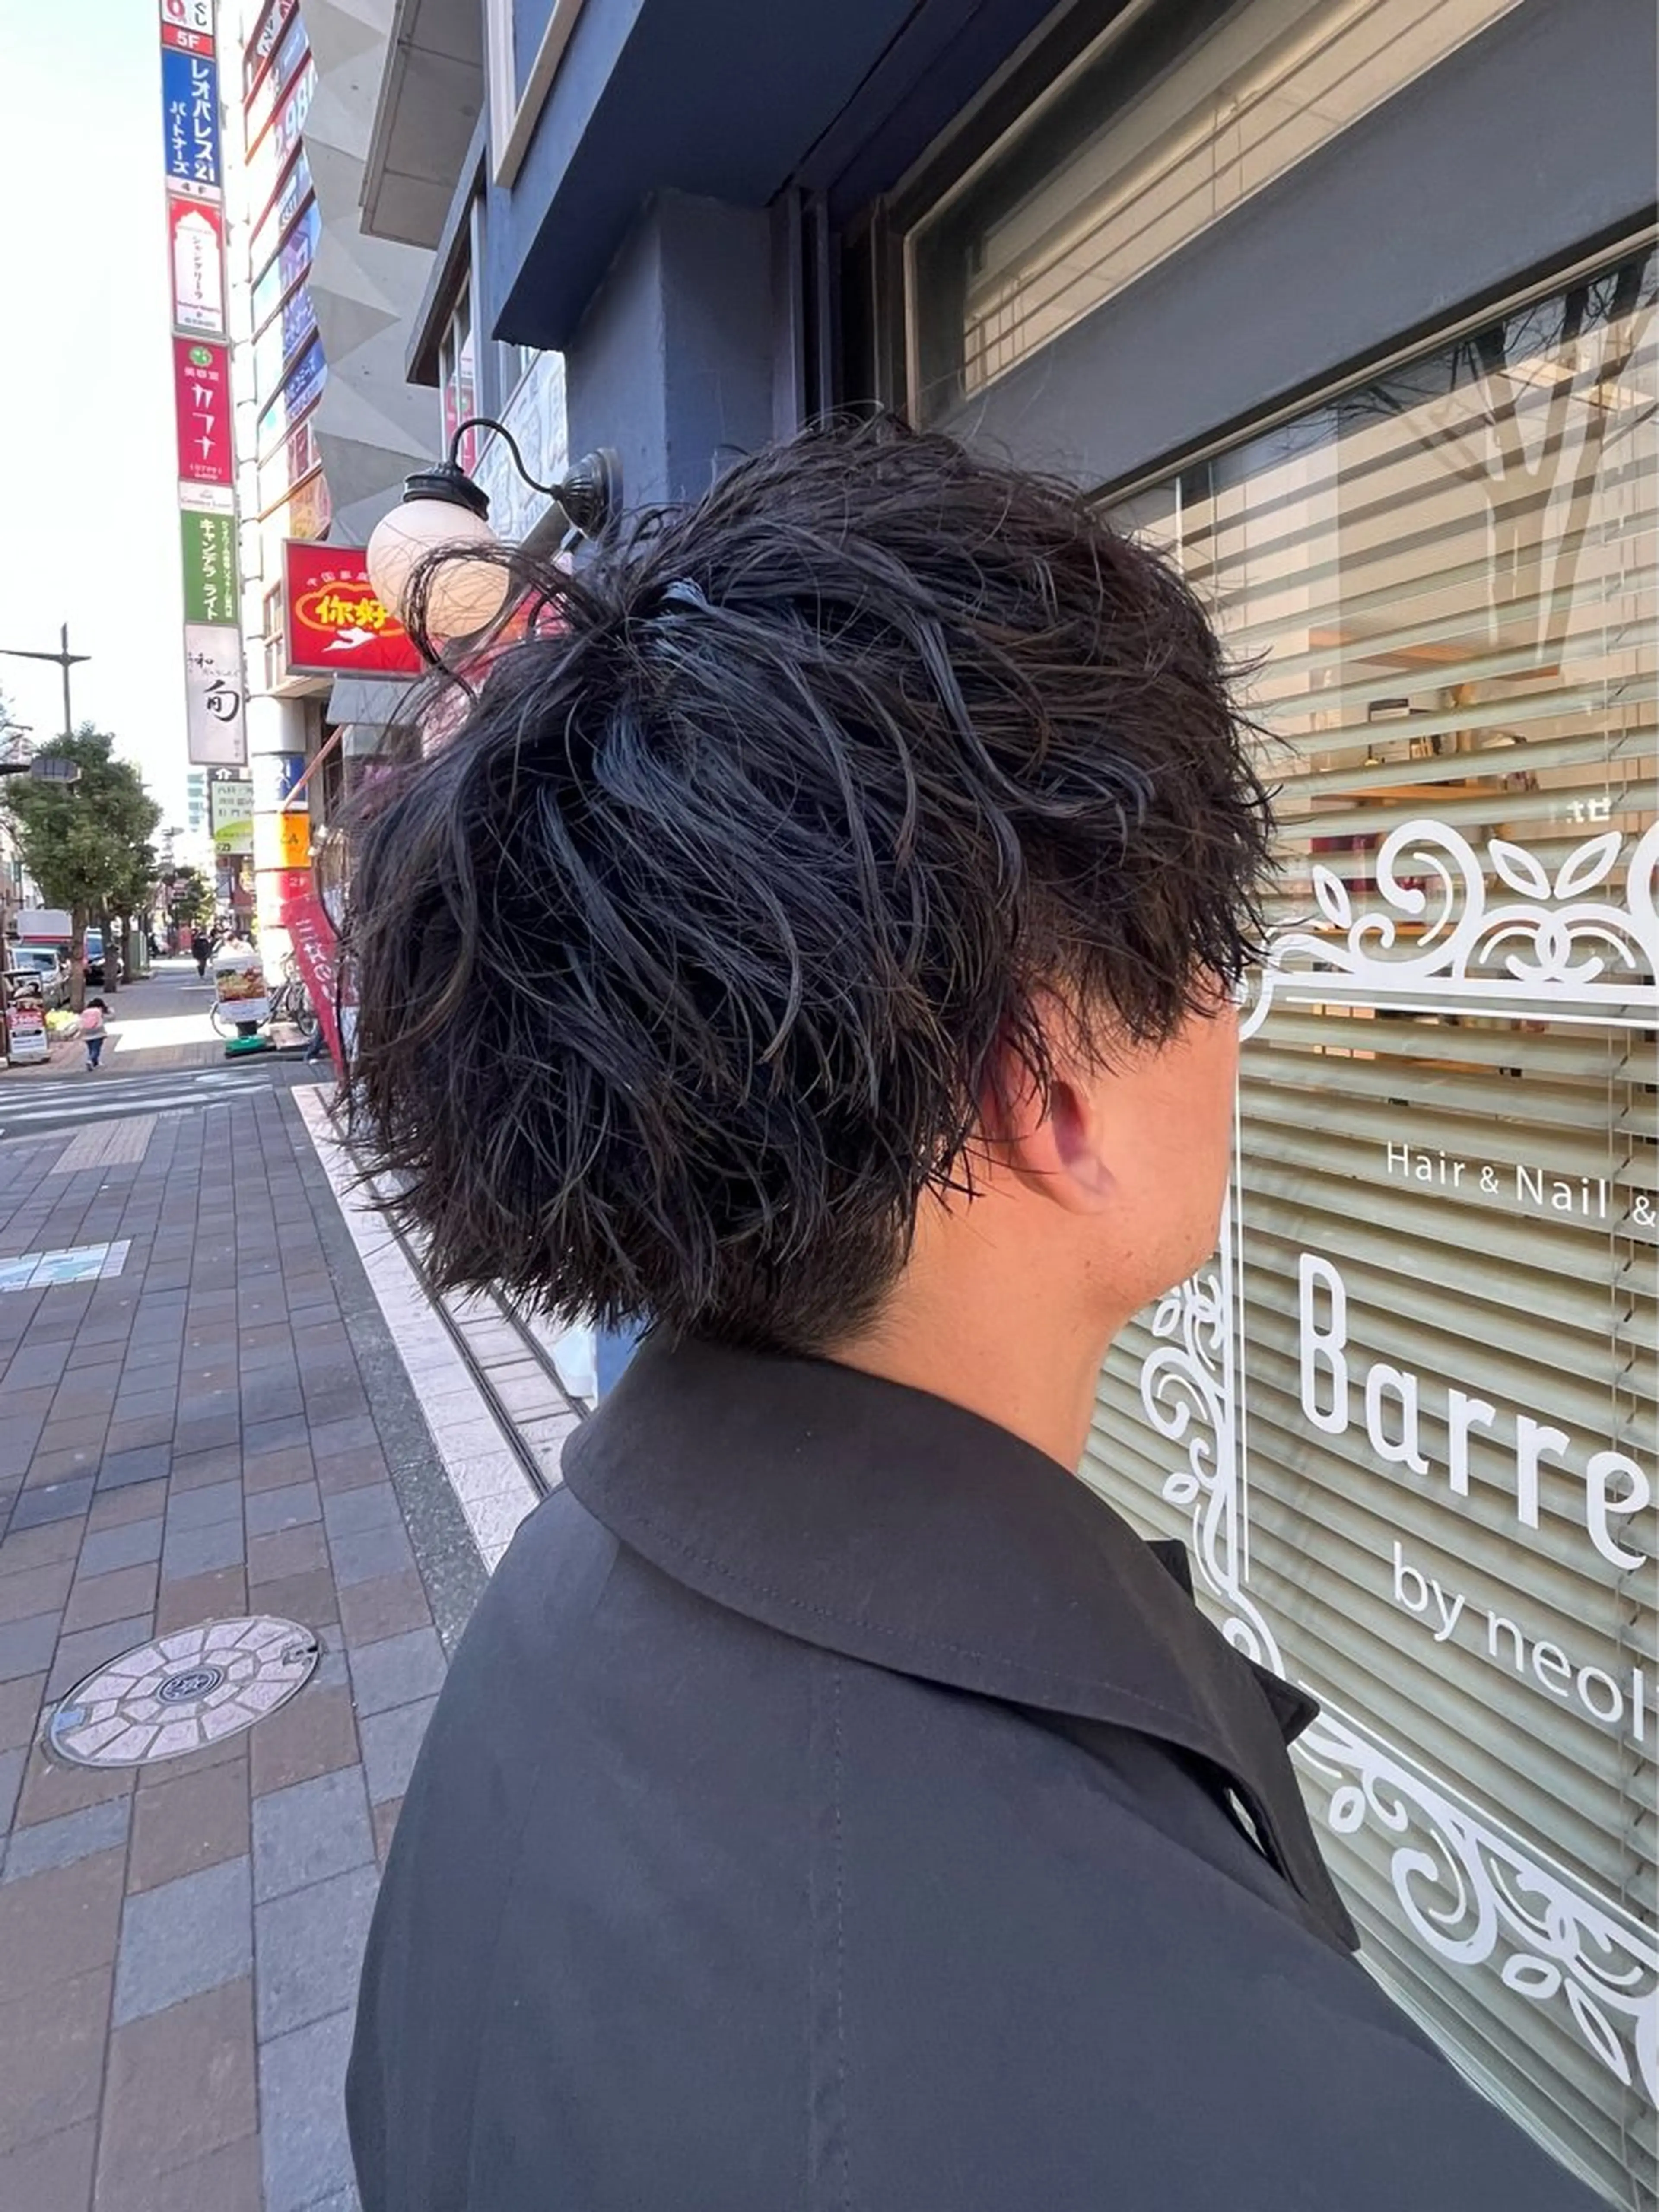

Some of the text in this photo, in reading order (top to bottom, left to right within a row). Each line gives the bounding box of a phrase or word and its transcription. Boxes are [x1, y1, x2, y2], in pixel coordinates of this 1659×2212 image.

[176, 30, 200, 49] 5F
[169, 99, 190, 175] パートナーズ
[191, 58, 215, 182] レオパレス21
[191, 383, 216, 461] カフナ
[315, 594, 386, 629] 你好
[203, 679, 240, 722] 旬
[1387, 1142, 1656, 1228] Hair & Nail &
[1300, 1253, 1650, 1570] Barre
[1394, 1541, 1659, 1742] by neol
